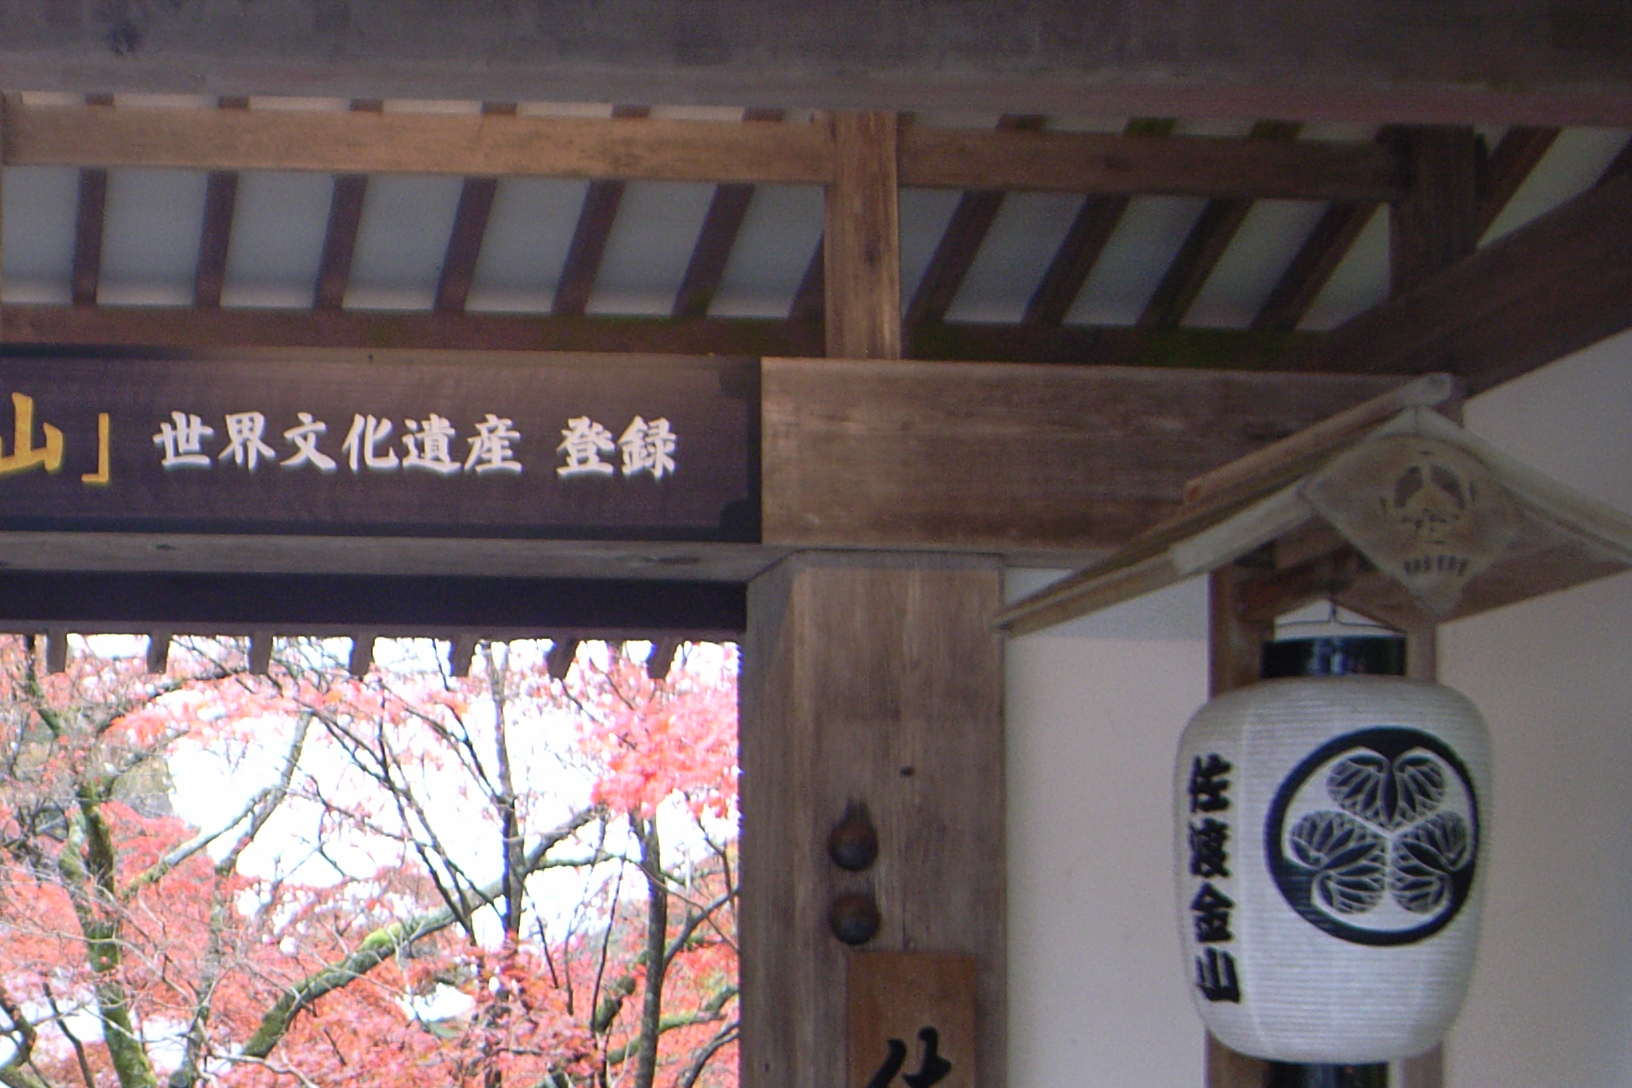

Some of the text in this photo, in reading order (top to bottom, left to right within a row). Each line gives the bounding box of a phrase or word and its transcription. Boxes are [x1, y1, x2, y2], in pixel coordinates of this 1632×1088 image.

[153, 410, 522, 474] 世界文化遺産
[556, 415, 676, 478] 登録
[1188, 753, 1241, 1004] 佐渡金山
